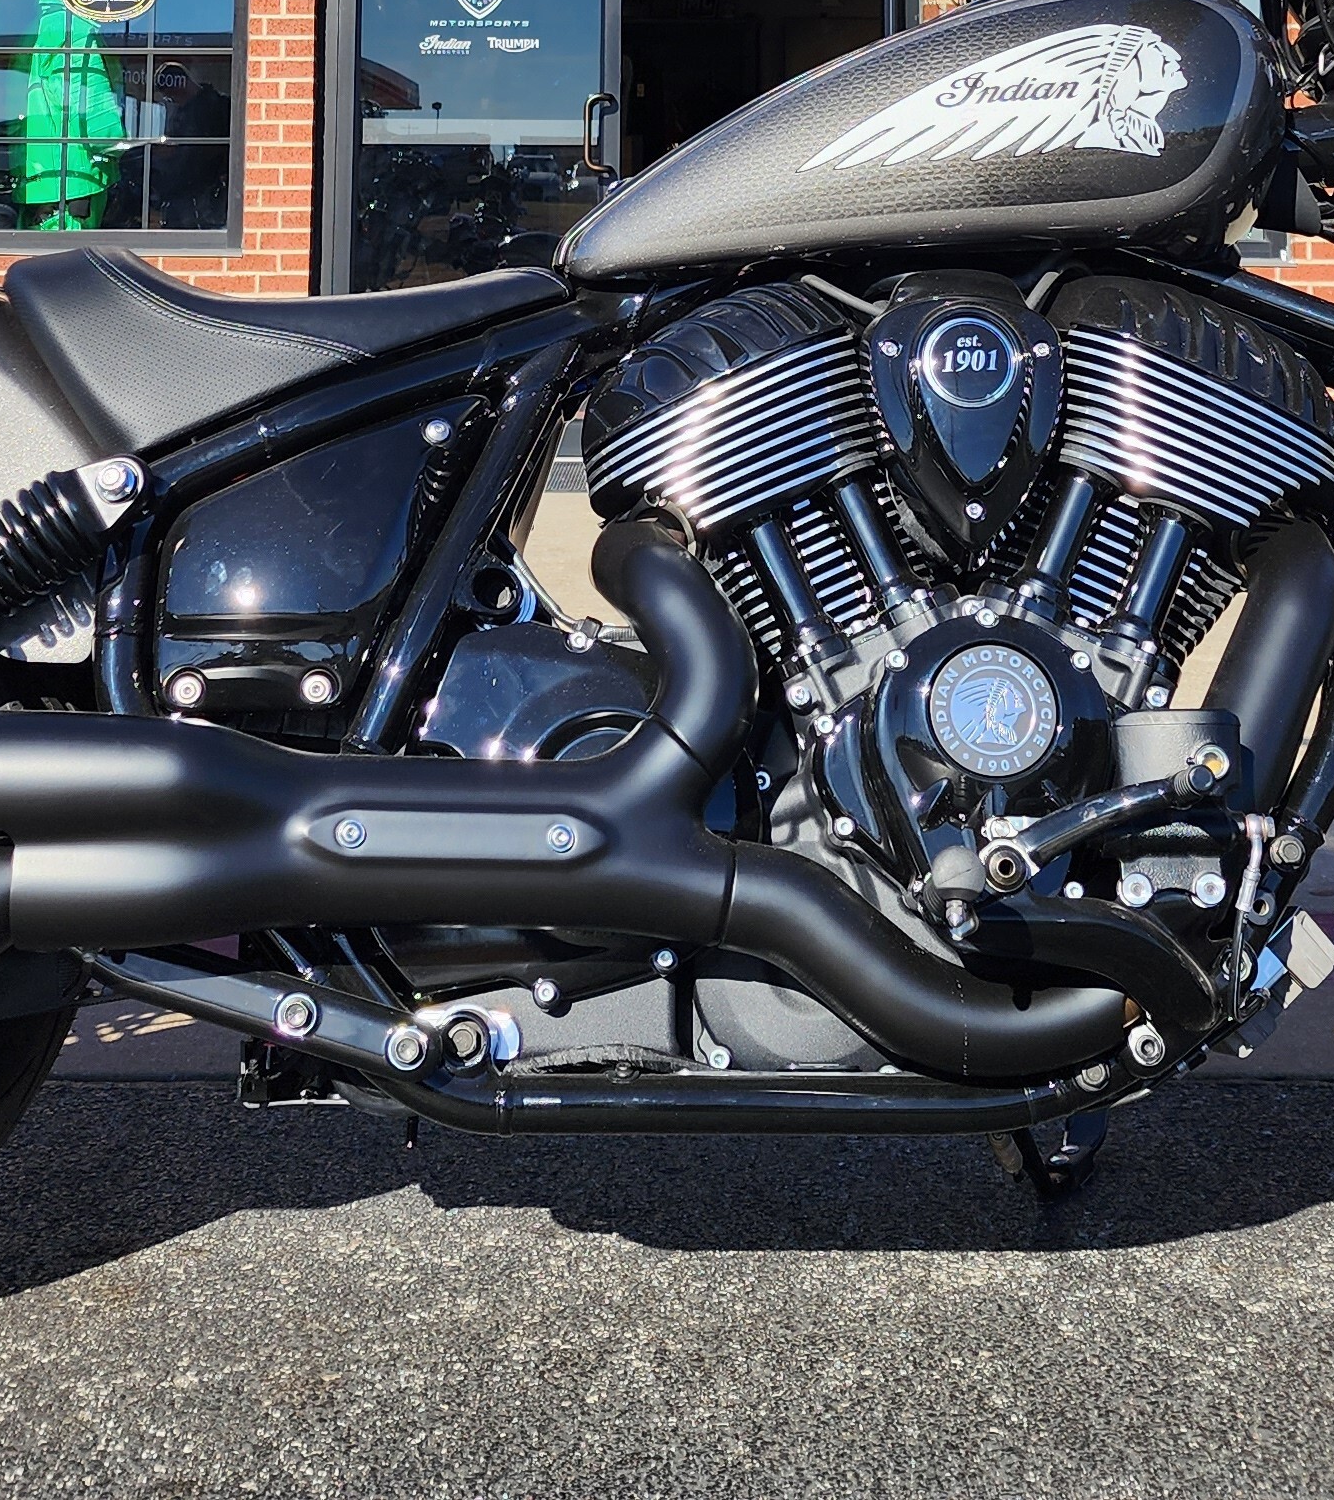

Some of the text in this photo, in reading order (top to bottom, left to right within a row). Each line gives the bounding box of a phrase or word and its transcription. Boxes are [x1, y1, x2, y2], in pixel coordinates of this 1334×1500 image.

[429, 19, 530, 28] MOTORSPORTS
[418, 34, 540, 53] Indian TRIUMPH
[935, 71, 1080, 108] Indian
[956, 334, 983, 347] est.
[941, 349, 998, 373] 1901
[934, 649, 1054, 751] INDIAN MOTORCYCLE
[976, 755, 1022, 772] 1901
